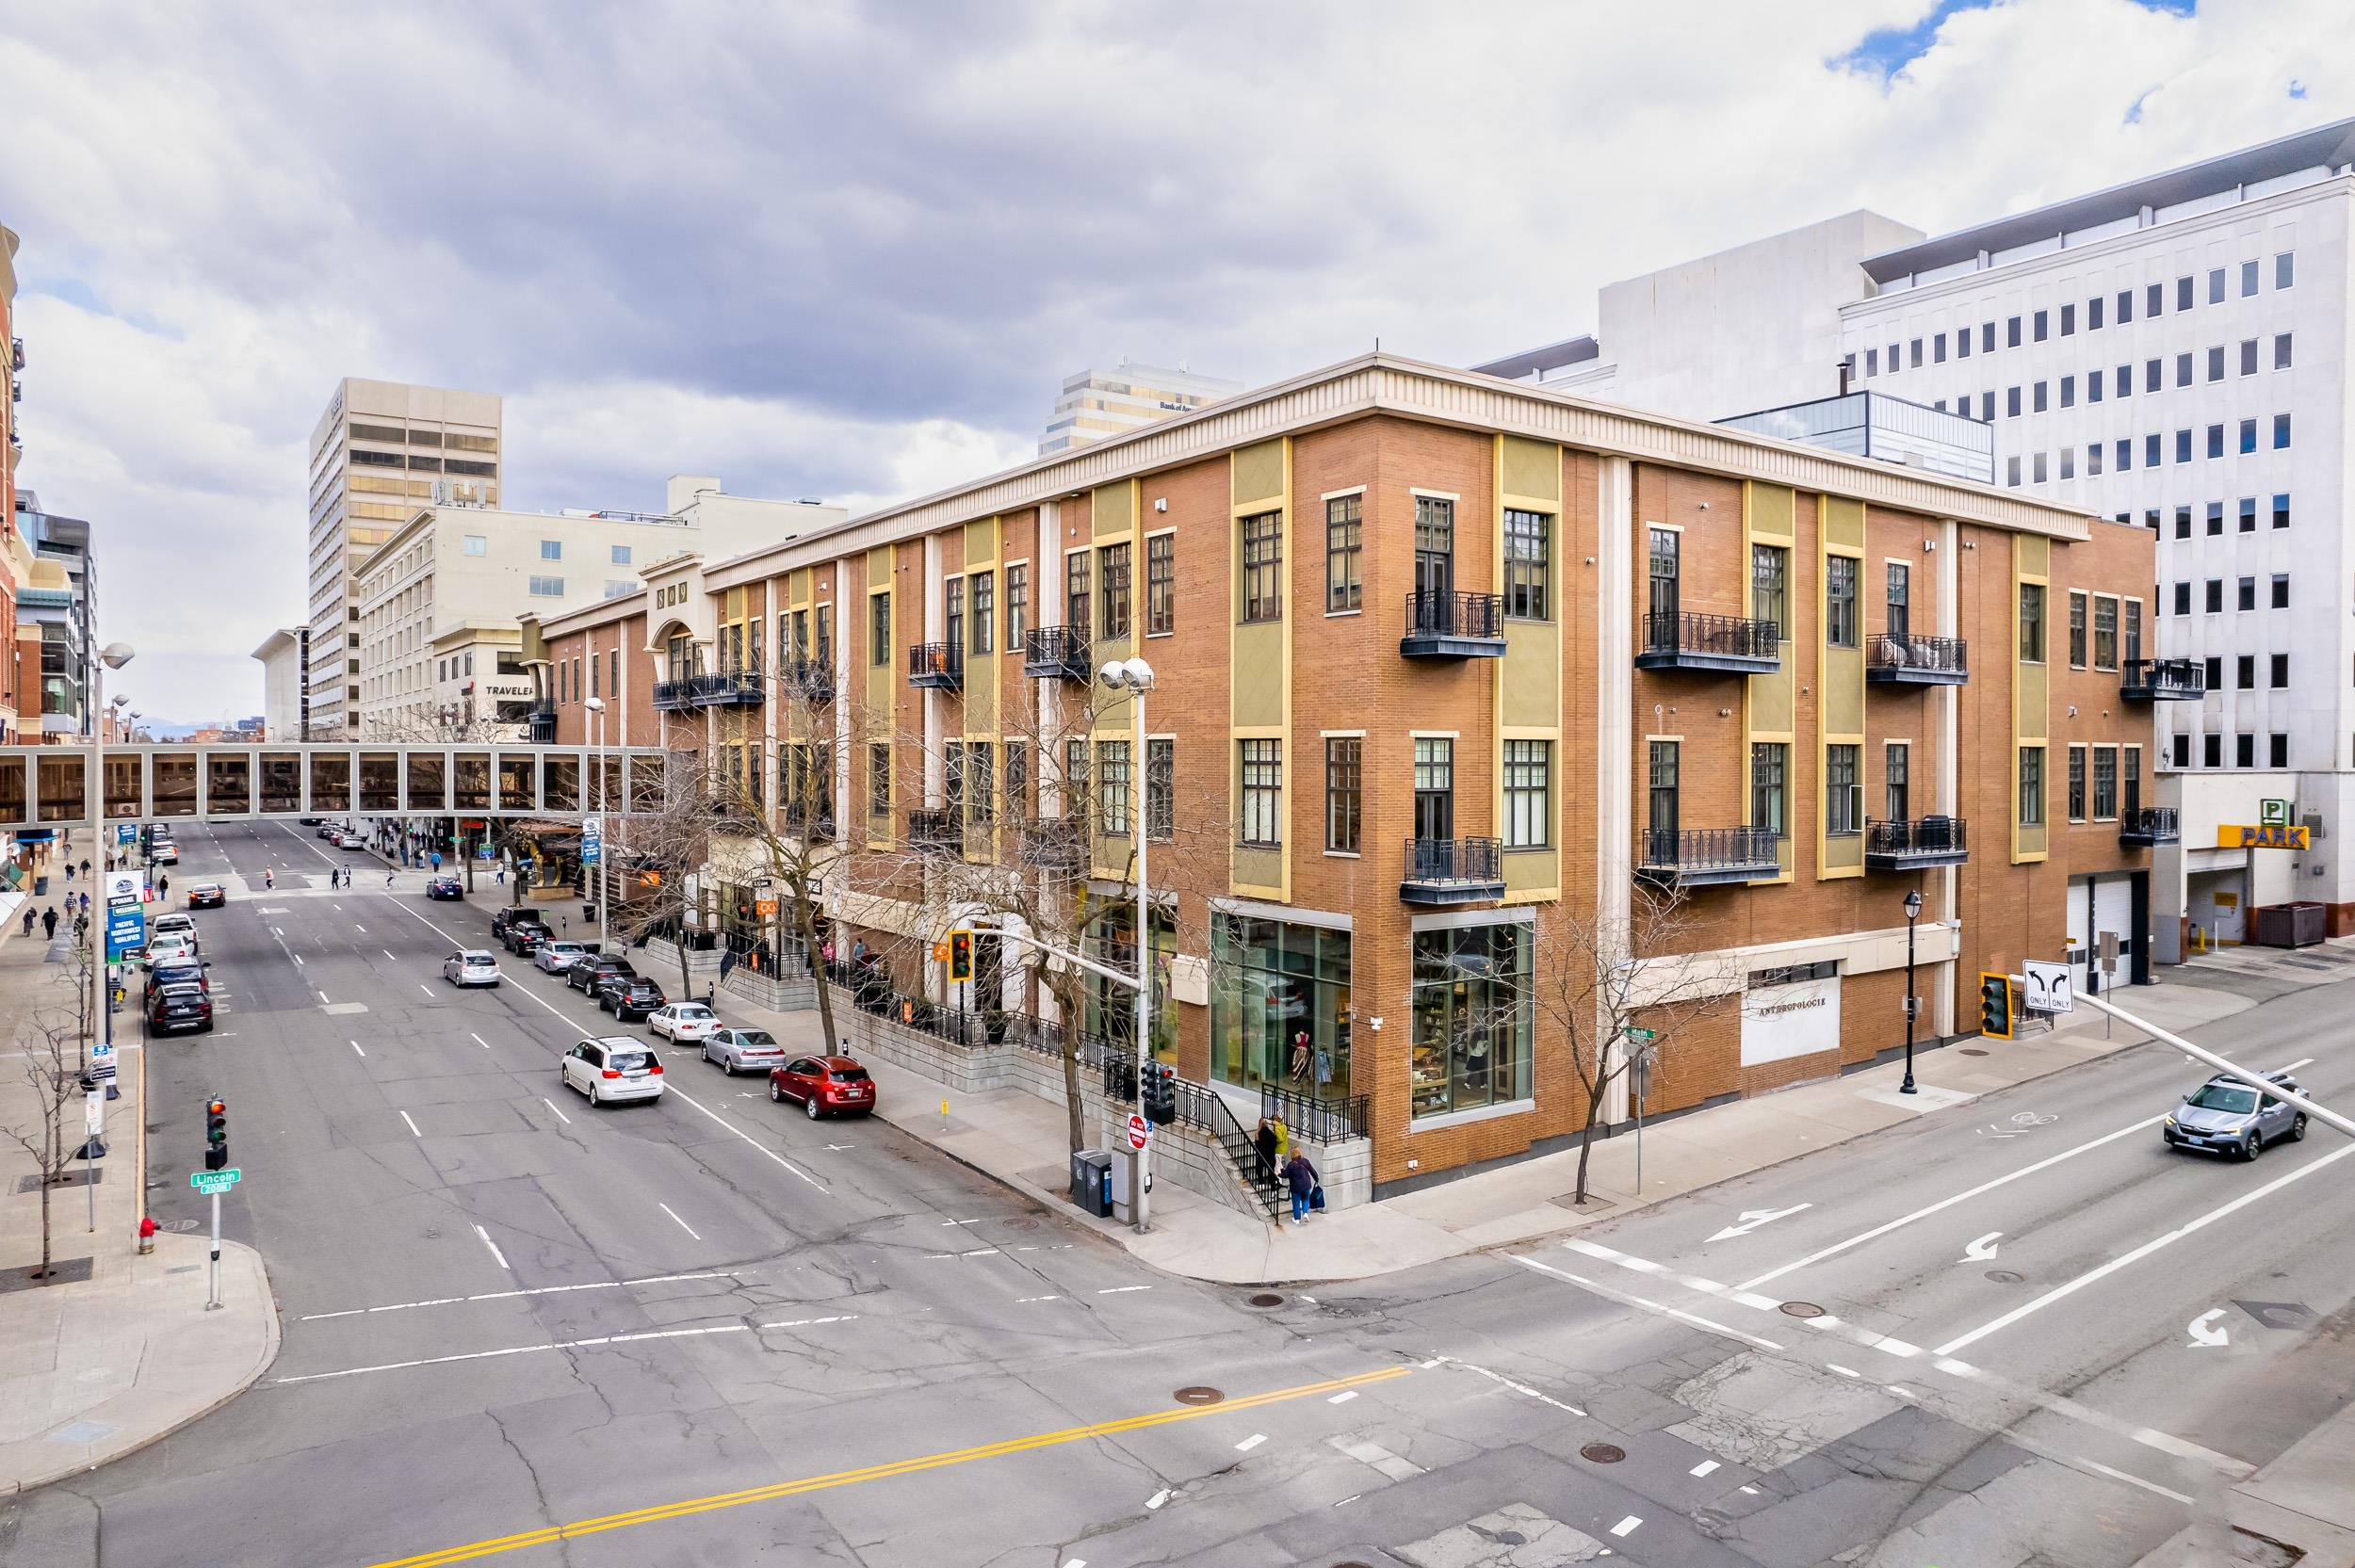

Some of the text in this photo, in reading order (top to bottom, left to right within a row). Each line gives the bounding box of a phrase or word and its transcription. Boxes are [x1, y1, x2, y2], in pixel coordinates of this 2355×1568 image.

[1160, 401, 1175, 411] Bank
[658, 584, 687, 608] 809
[2266, 802, 2281, 818] P
[2242, 827, 2305, 846] PARK
[110, 896, 135, 906] SPOKANE
[115, 919, 135, 929] PACIFIC
[110, 926, 141, 937] NORTHWEST
[114, 933, 140, 944] QUALIFIER
[2030, 995, 2070, 1009] ONLY ONLY
[1631, 1028, 1648, 1037] Main
[1131, 1134, 1144, 1143] ENTER
[197, 1172, 236, 1185] Lincoln
